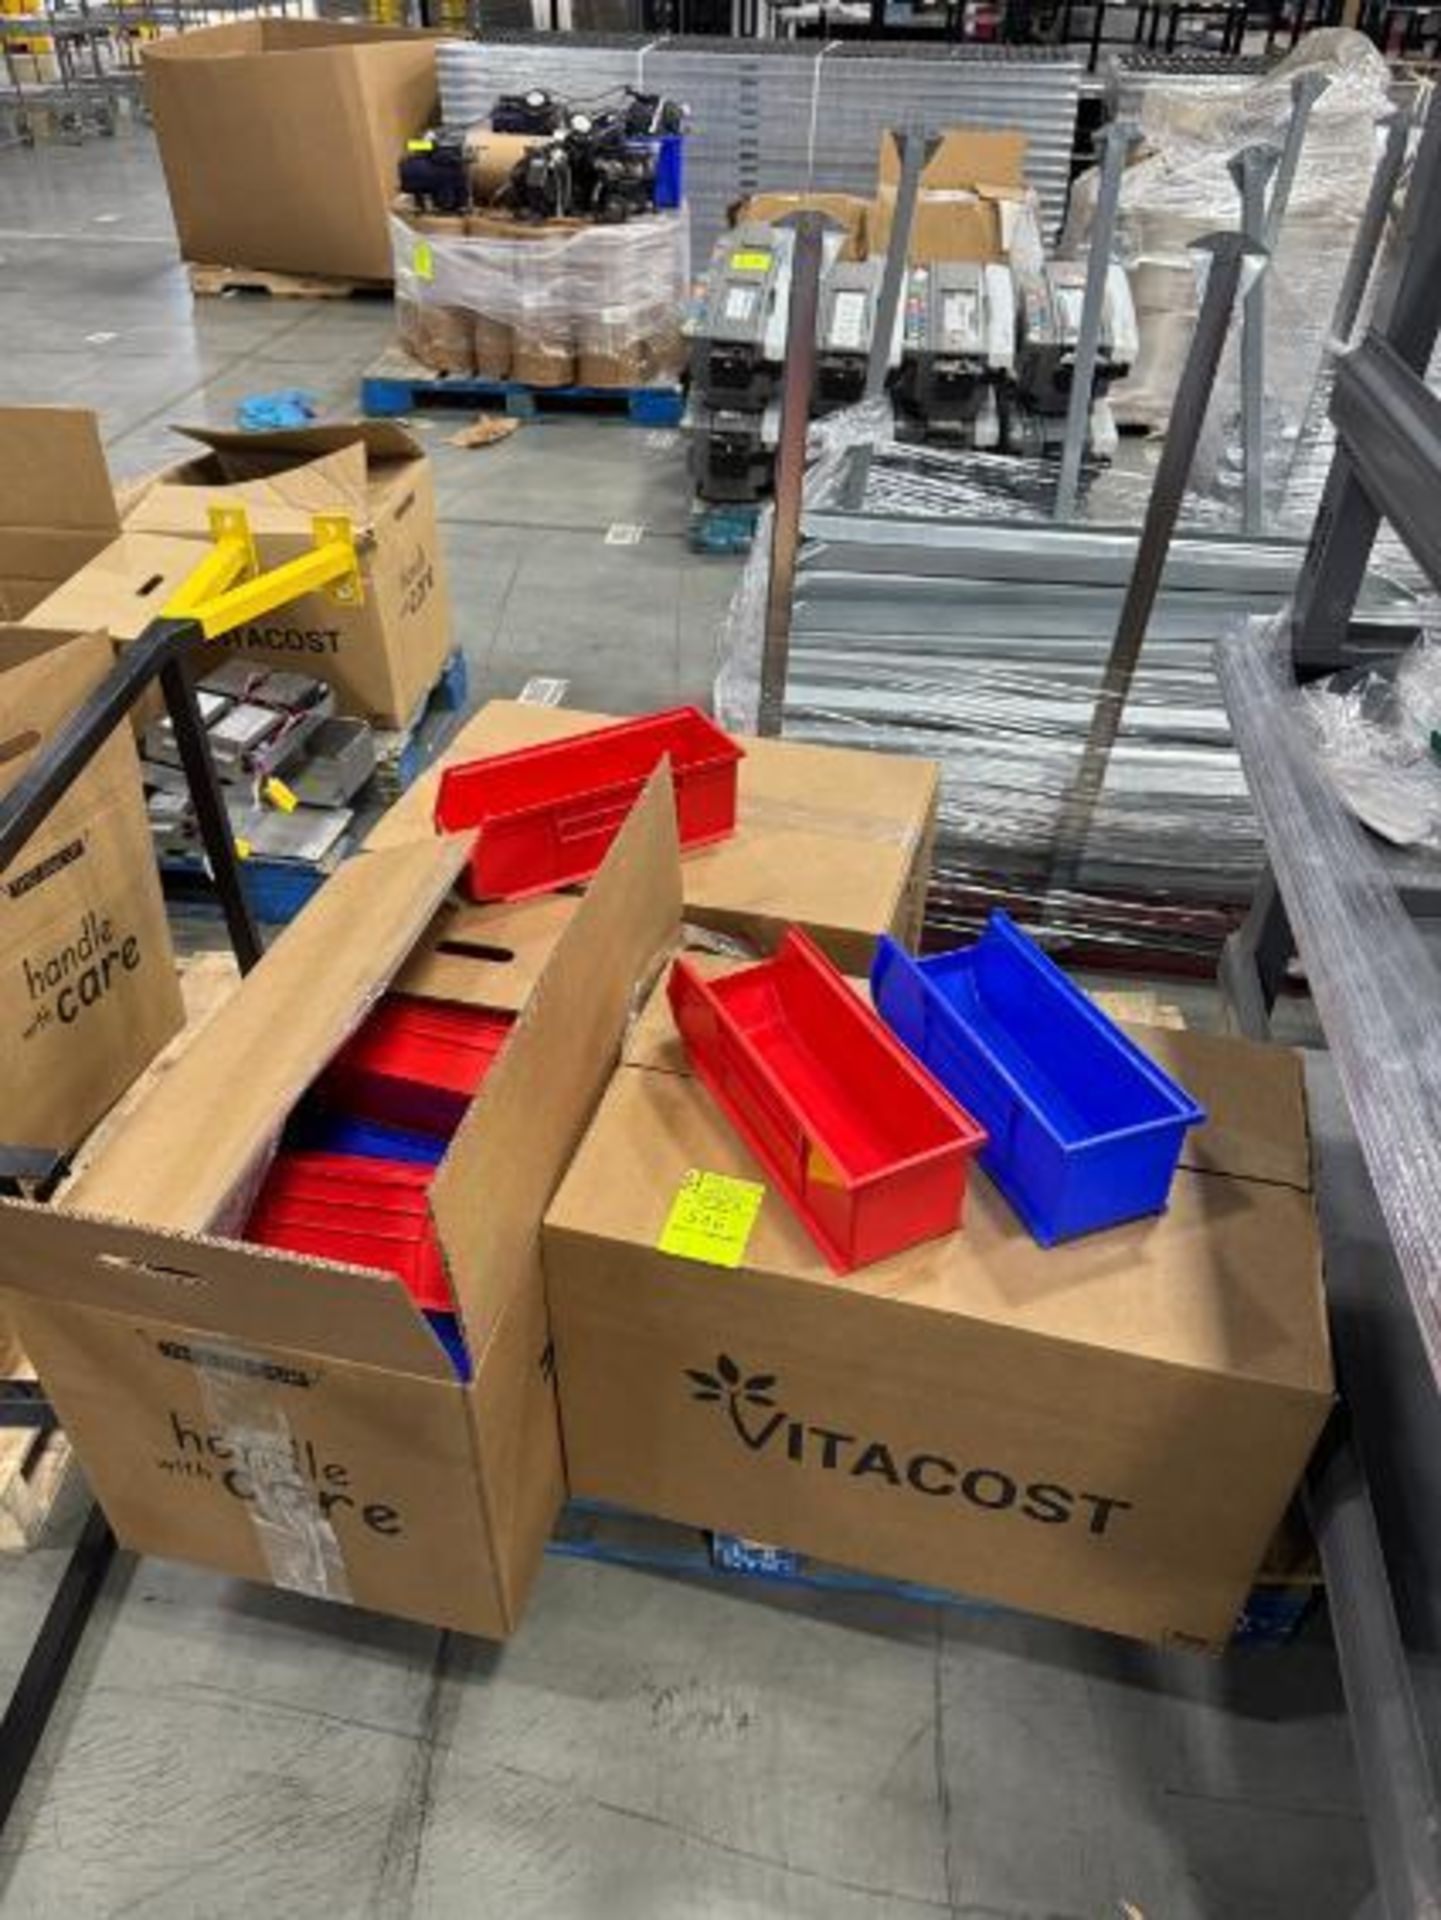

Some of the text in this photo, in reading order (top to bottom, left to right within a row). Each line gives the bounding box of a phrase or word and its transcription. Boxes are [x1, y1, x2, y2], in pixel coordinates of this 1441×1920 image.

[207, 626, 341, 653] TACOST
[22, 909, 113, 999] handle
[56, 934, 141, 1024] care
[169, 1412, 352, 1487] hale
[730, 1393, 1133, 1536] VITACOST
